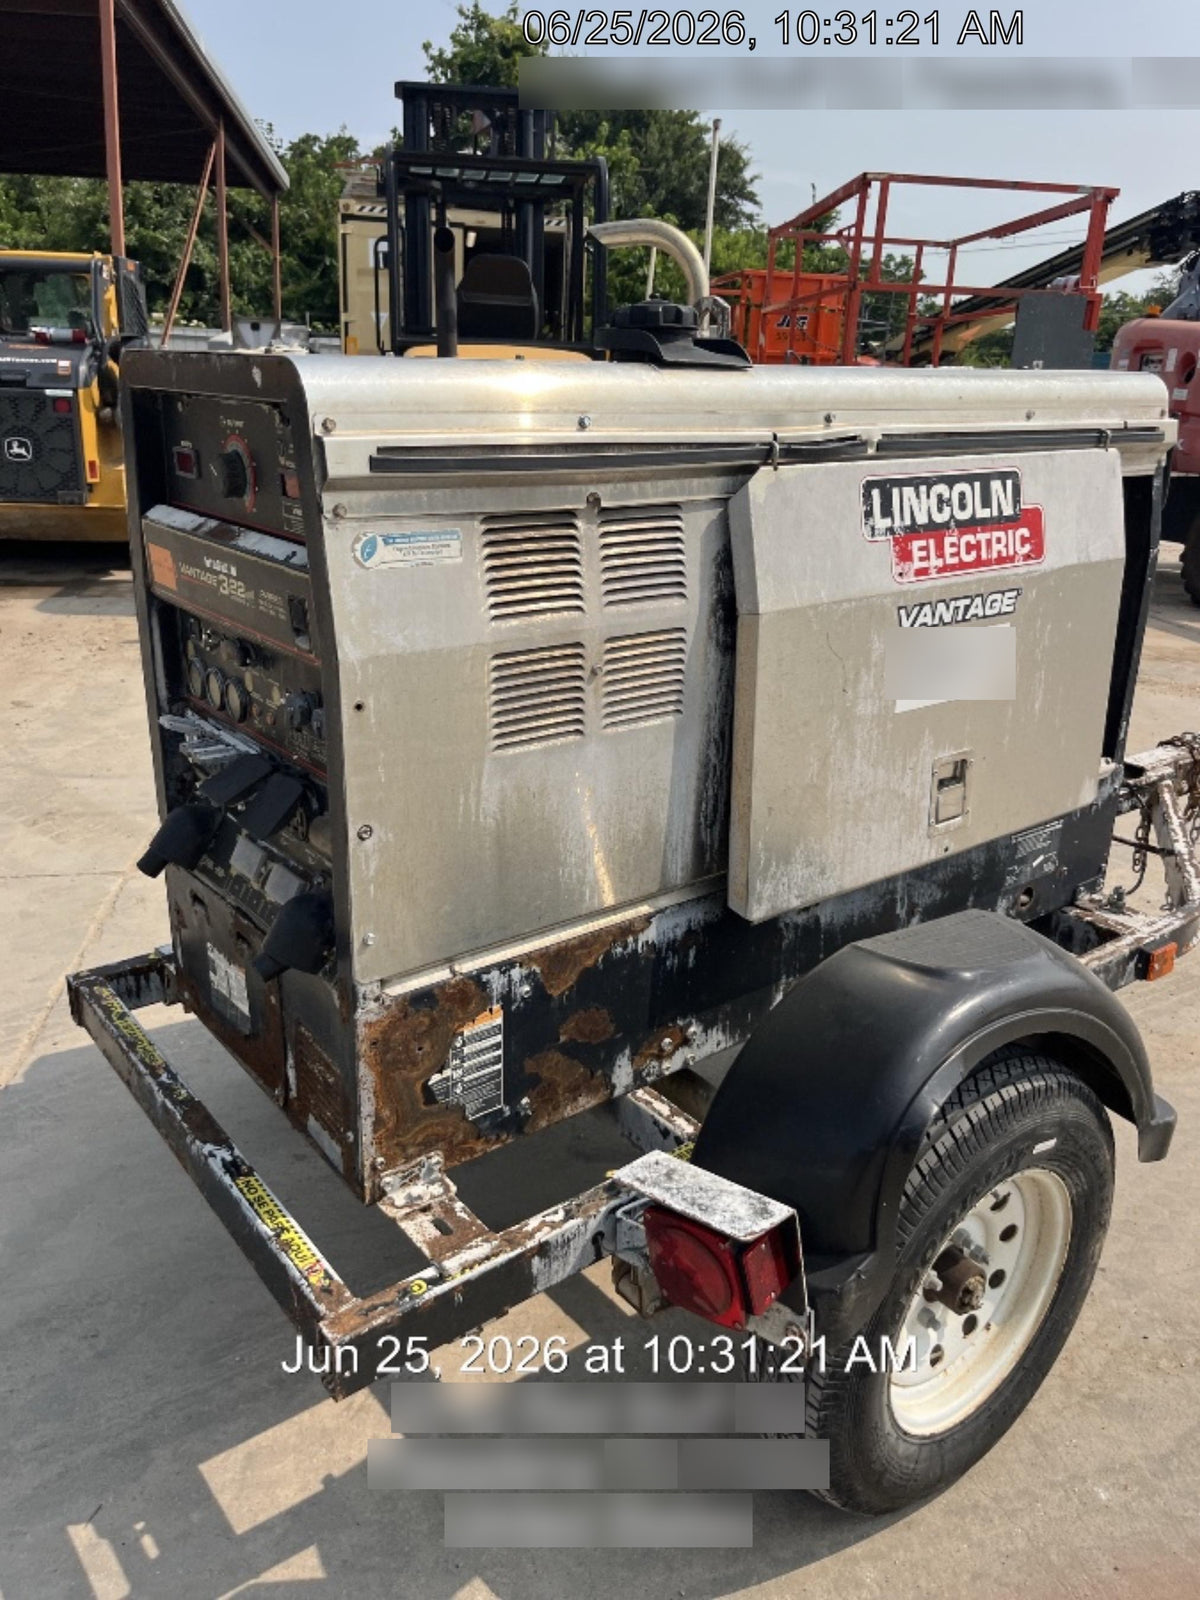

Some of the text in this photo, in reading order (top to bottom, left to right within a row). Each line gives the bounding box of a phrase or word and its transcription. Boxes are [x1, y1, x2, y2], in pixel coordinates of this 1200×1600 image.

[871, 480, 1013, 528] LINCOLN
[911, 527, 1031, 568] ELECTRIC
[218, 573, 246, 599] 322
[897, 589, 1019, 628] VANTAGE
[244, 1179, 259, 1196] NO
[253, 1195, 270, 1210] SE
